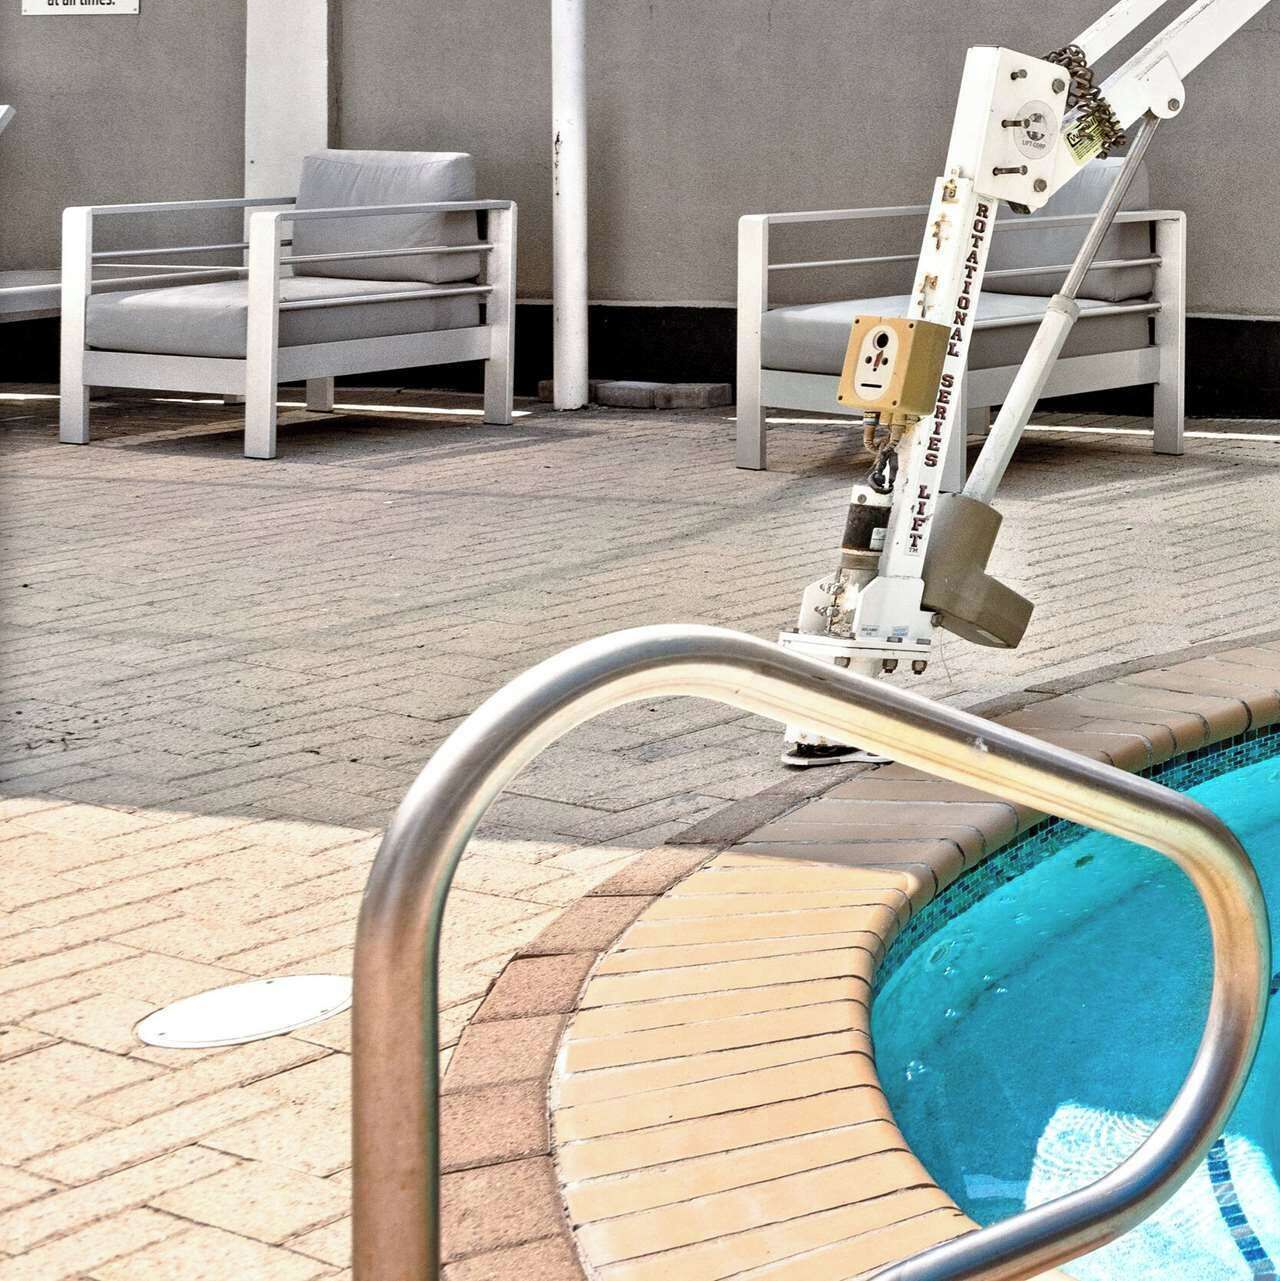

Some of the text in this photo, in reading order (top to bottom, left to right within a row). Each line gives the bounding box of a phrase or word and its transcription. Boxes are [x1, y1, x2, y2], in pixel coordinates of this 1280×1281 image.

[946, 202, 989, 358] ROTATIONAL
[923, 373, 955, 468] SERIES
[909, 484, 931, 549] LIFT
